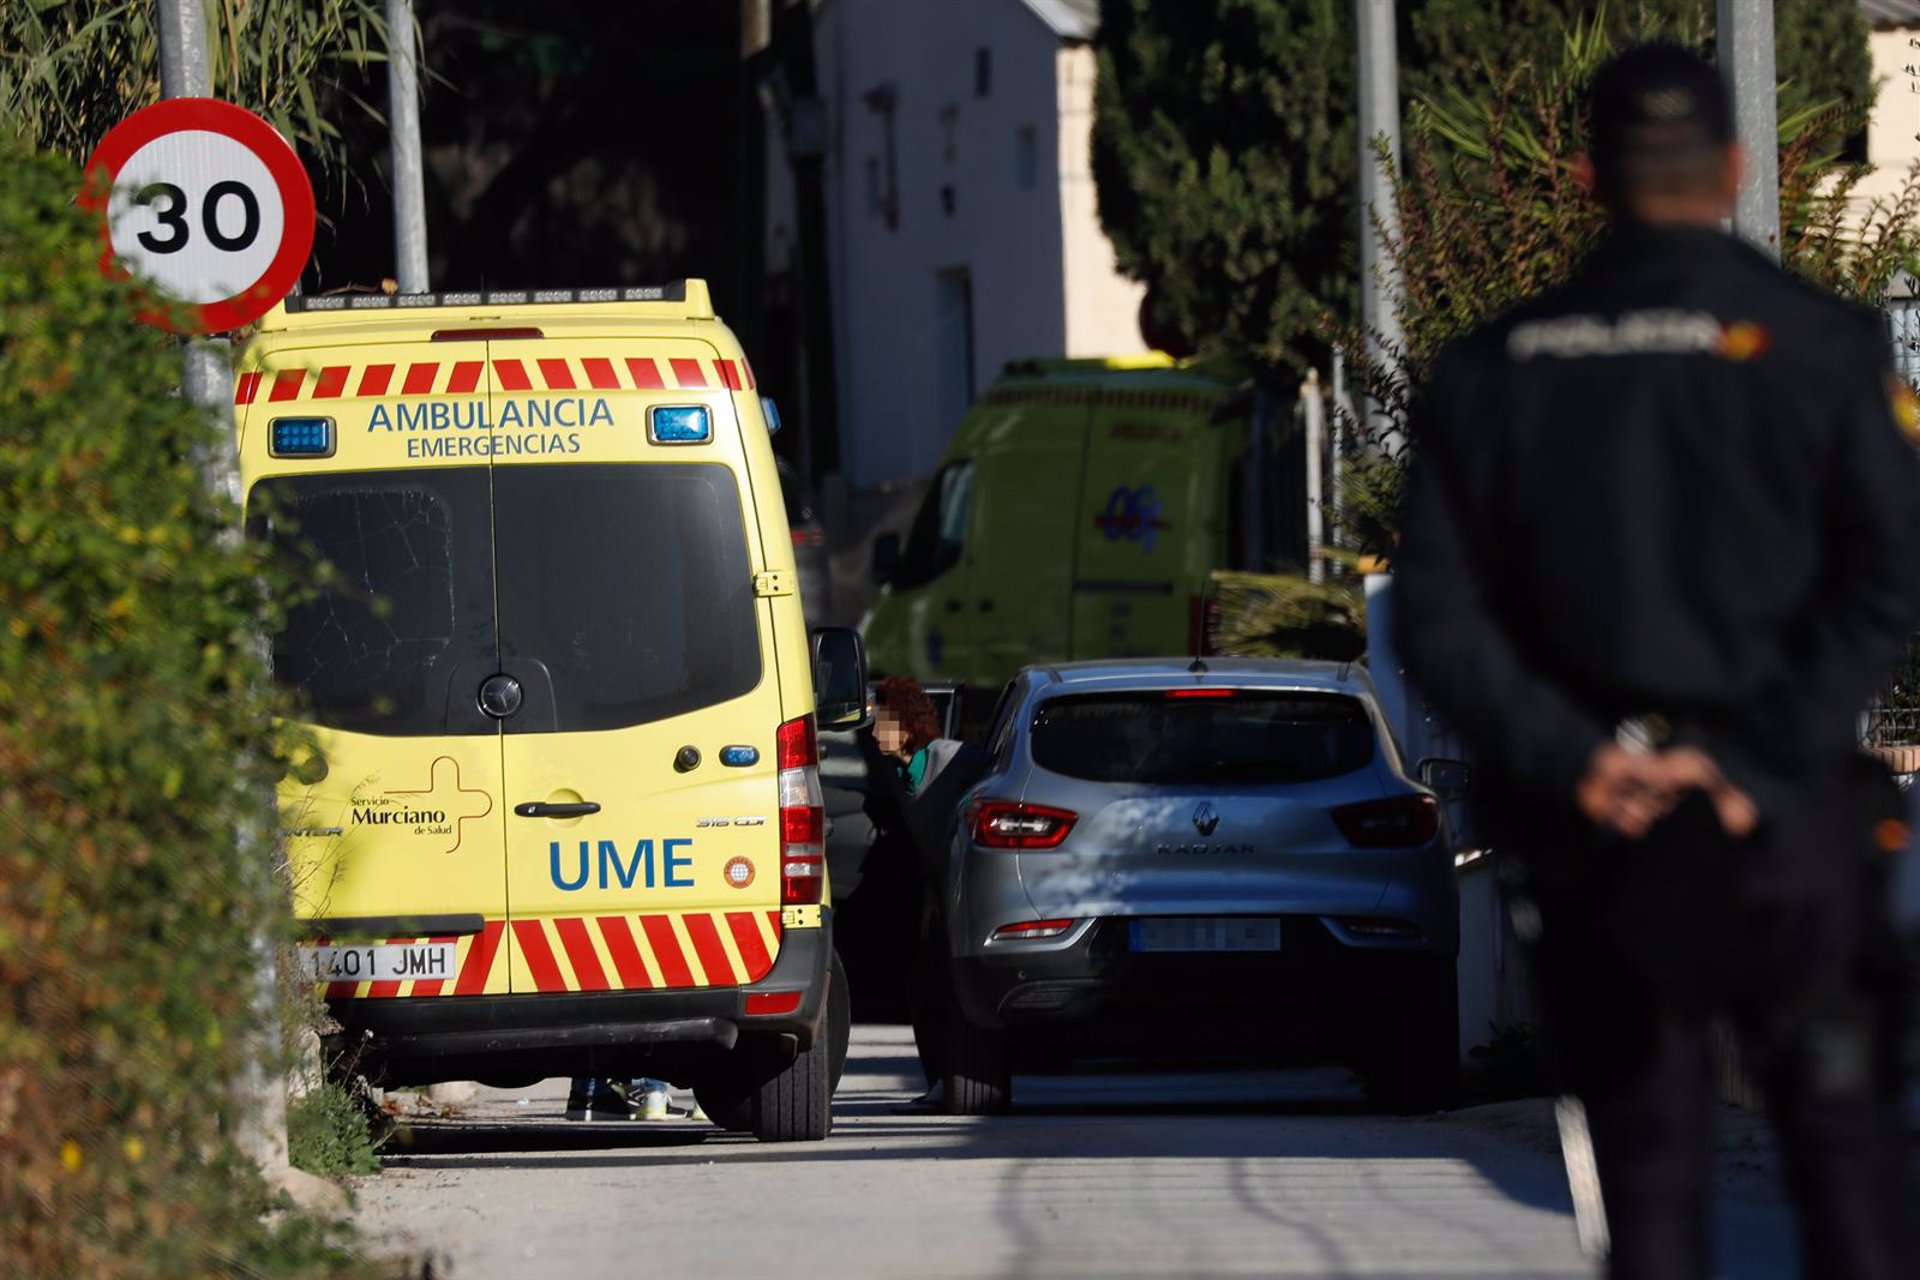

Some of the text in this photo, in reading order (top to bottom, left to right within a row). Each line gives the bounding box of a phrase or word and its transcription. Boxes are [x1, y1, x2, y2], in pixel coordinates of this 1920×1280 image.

[136, 180, 260, 254] 30
[367, 398, 615, 433] AMBULANCIA
[407, 433, 581, 459] EMERGENCIAS
[351, 797, 390, 807] Servicio
[351, 806, 446, 825] Murciano
[414, 825, 452, 835] de Salud
[1156, 844, 1256, 855] KADJAR
[549, 838, 695, 891] UME
[392, 948, 446, 976] JMH
